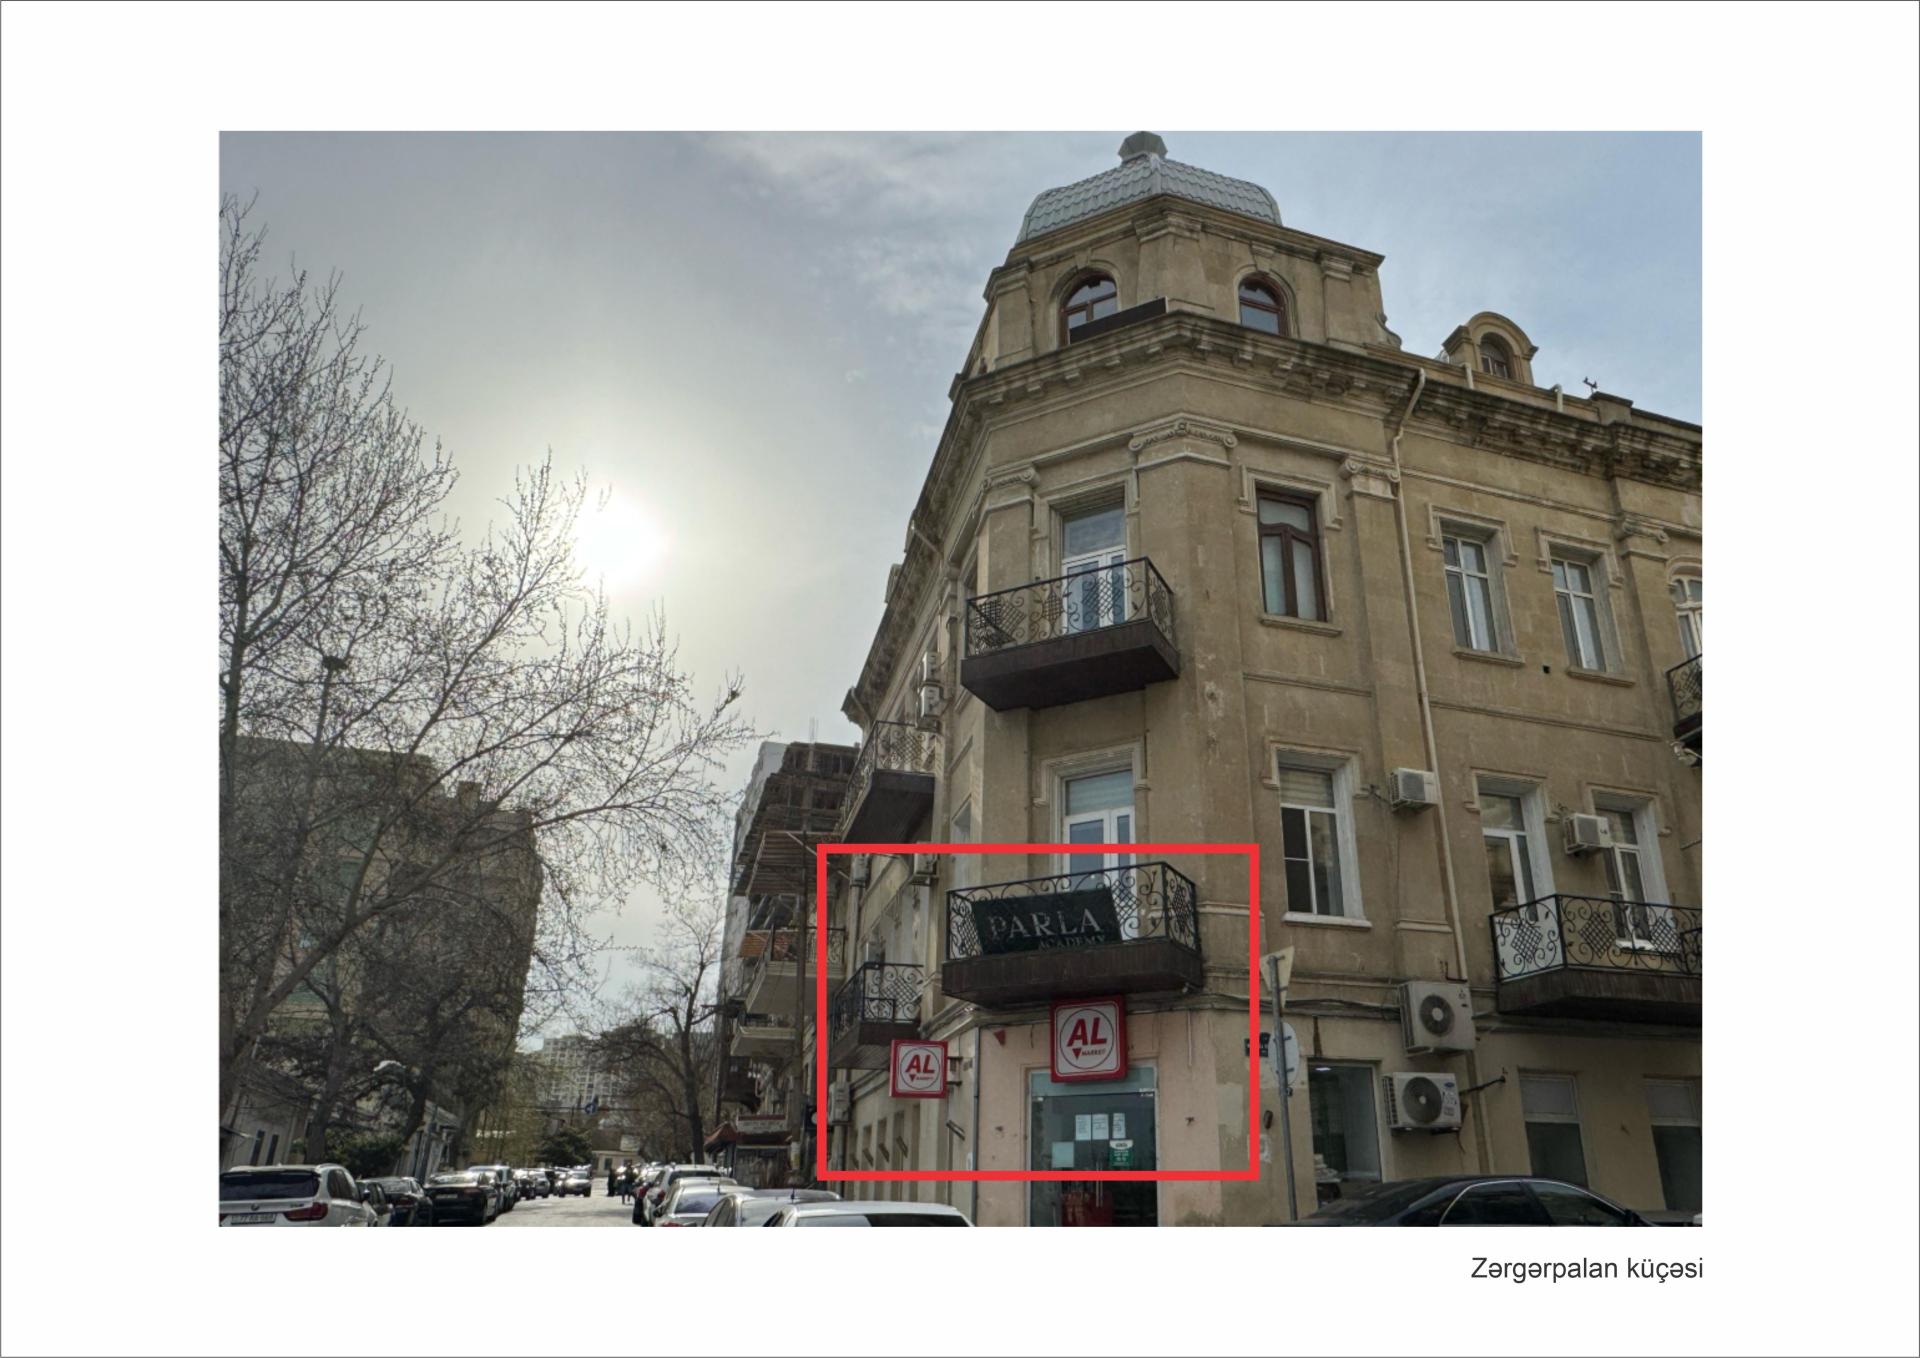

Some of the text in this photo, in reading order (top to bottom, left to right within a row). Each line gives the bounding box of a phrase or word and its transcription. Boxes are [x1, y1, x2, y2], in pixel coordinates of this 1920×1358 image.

[988, 908, 1103, 940] PARLA
[1066, 1016, 1107, 1047] AL
[905, 1054, 935, 1073] AL
[1082, 1049, 1106, 1057] MARKET
